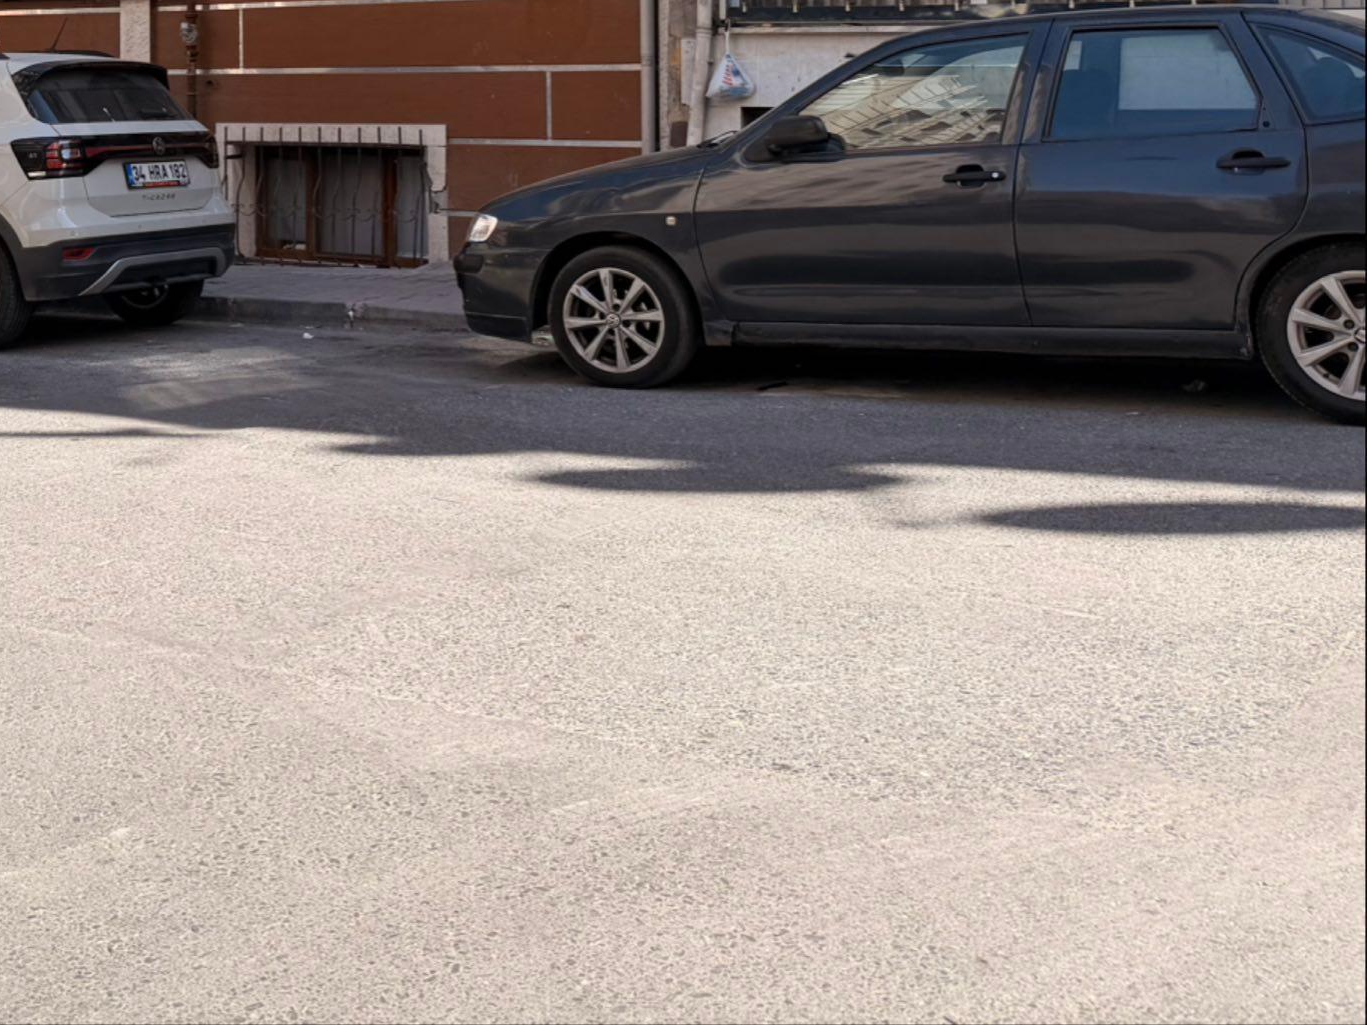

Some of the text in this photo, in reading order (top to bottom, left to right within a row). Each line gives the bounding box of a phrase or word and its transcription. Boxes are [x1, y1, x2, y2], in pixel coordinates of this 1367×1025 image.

[132, 163, 187, 181] 34 HRA 182
